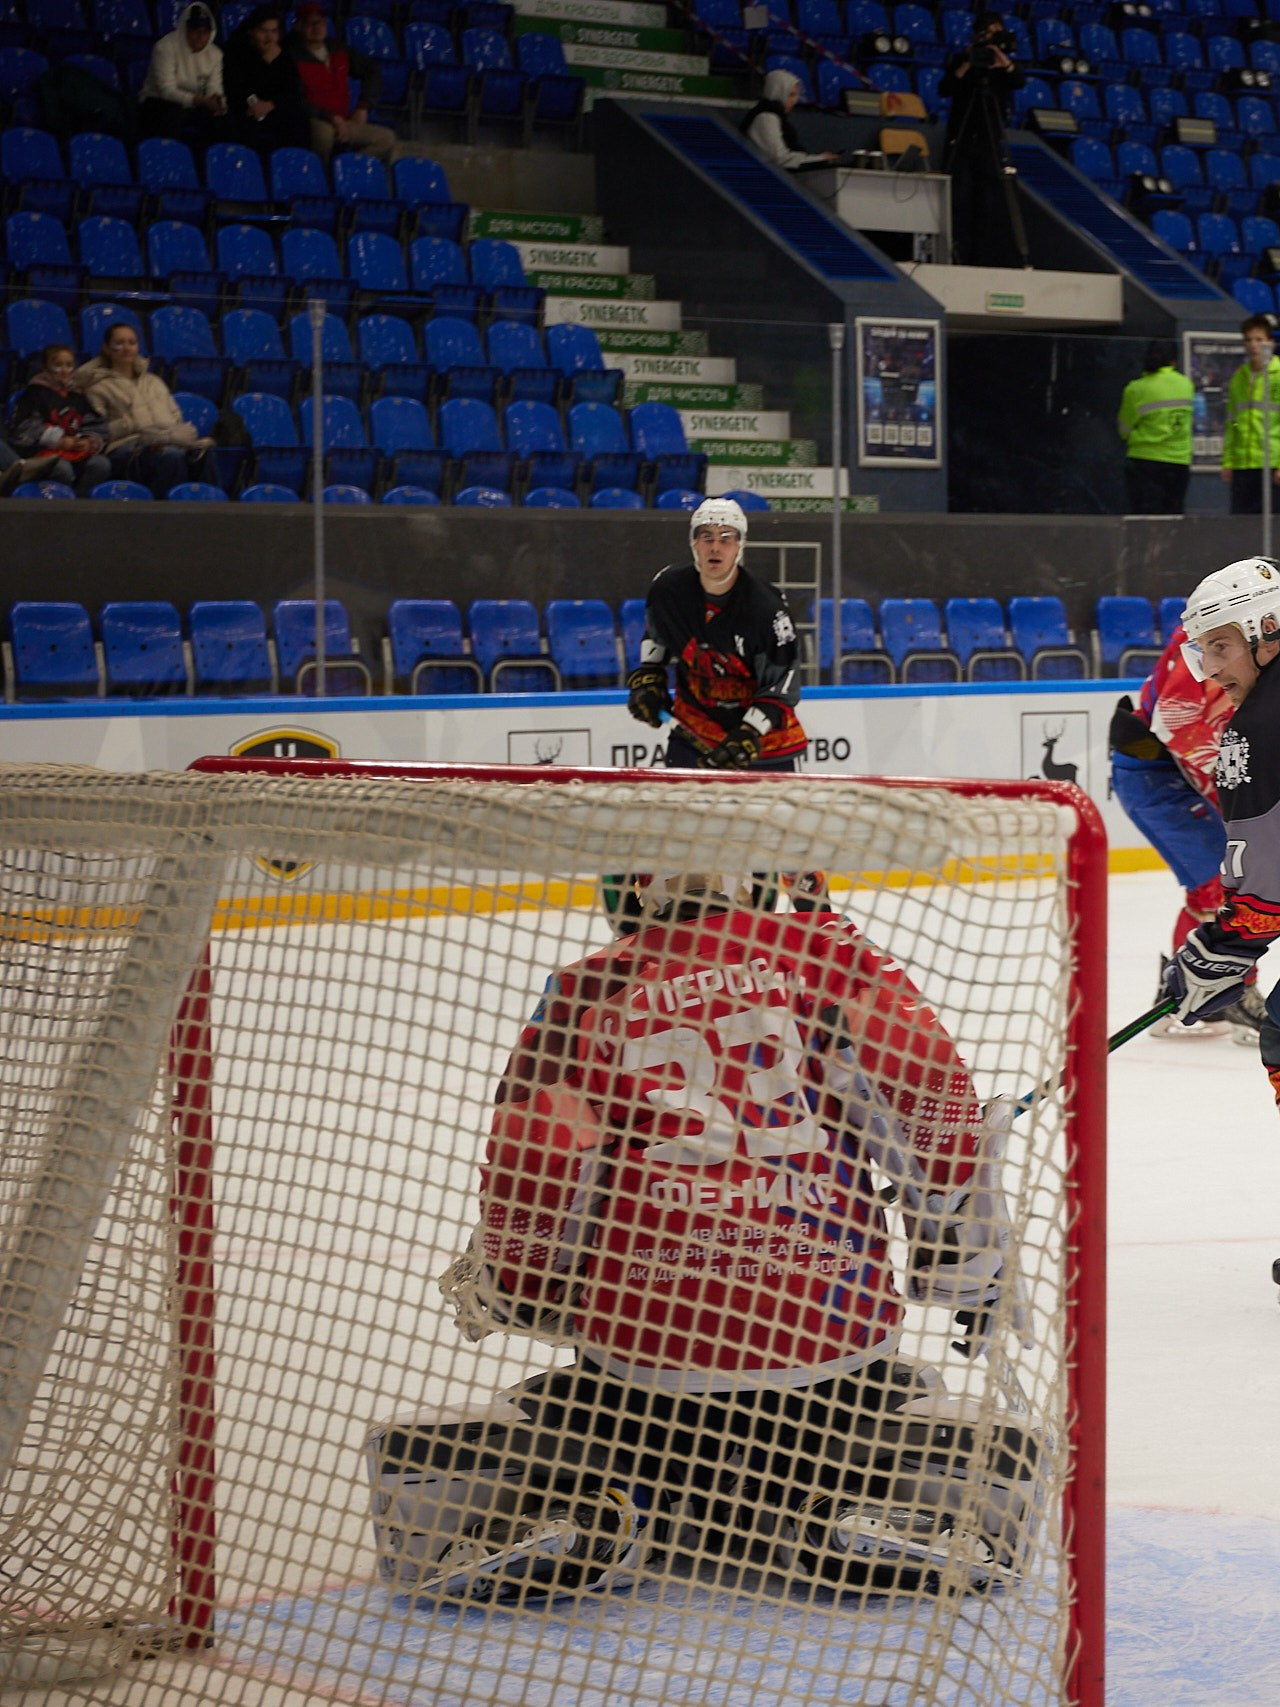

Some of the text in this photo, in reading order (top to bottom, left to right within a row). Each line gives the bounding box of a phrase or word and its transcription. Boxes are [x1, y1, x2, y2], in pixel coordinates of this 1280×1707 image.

[577, 27, 640, 48] SYNERGETIC
[621, 73, 685, 93] SYNERGETIC
[529, 248, 598, 268] SYNERGETIC
[579, 304, 648, 324] SYNERGETIC
[633, 359, 701, 376] SYNERGETIC
[690, 415, 759, 432] SYNERGETIC
[746, 471, 814, 489] SYNERGETIC
[1219, 839, 1248, 879] 7
[621, 1005, 830, 1167] 33
[651, 1172, 838, 1213] ФЕНИКС
